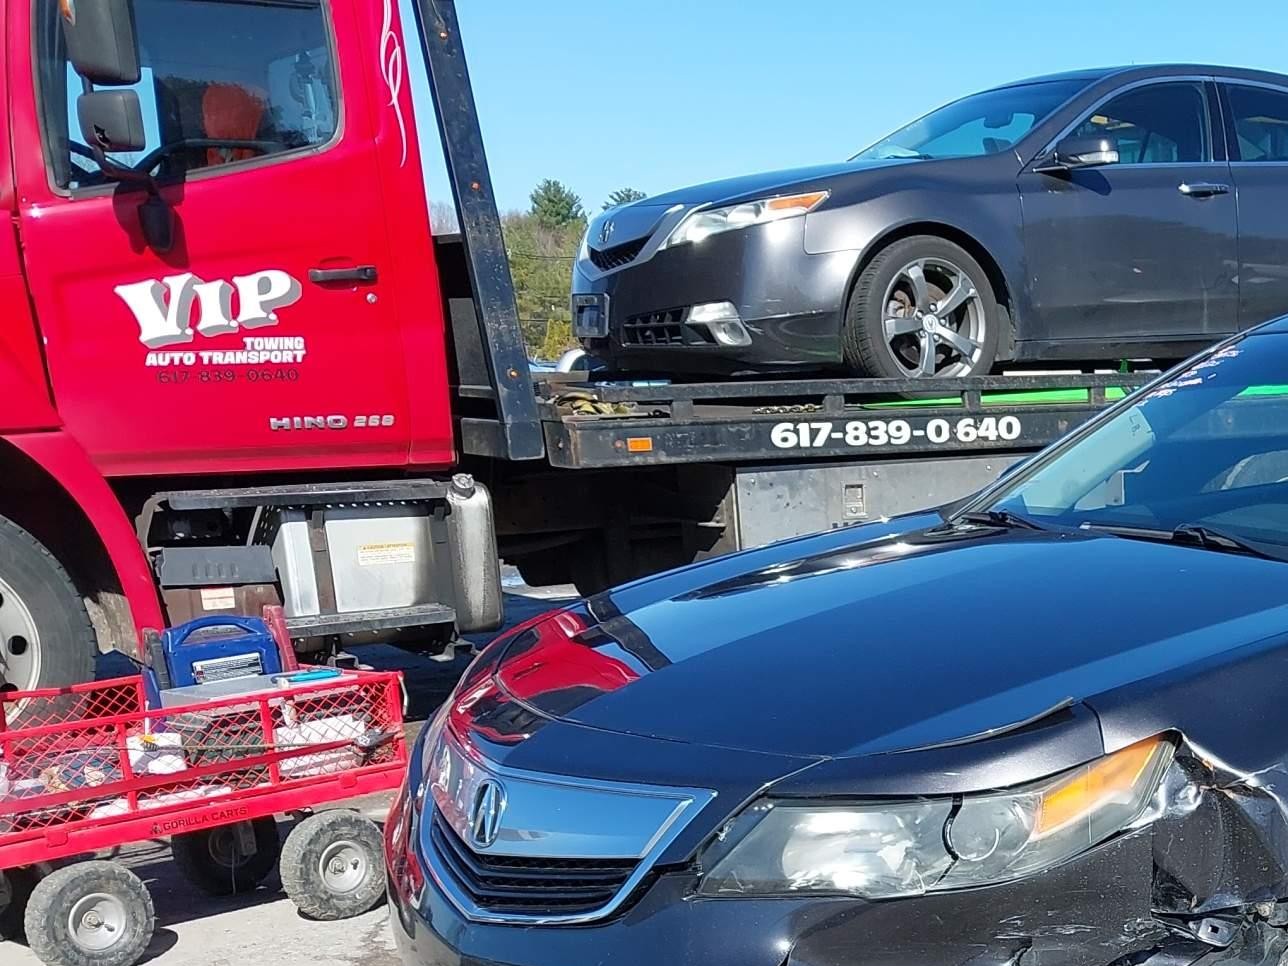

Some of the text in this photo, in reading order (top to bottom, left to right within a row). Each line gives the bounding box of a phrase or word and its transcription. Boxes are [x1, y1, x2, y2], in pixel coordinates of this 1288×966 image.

[243, 336, 305, 351] TOWING
[145, 350, 306, 367] AUTO TRANSPORT
[269, 414, 395, 431] HINO 268
[163, 806, 248, 832] GORILLA CARTS
